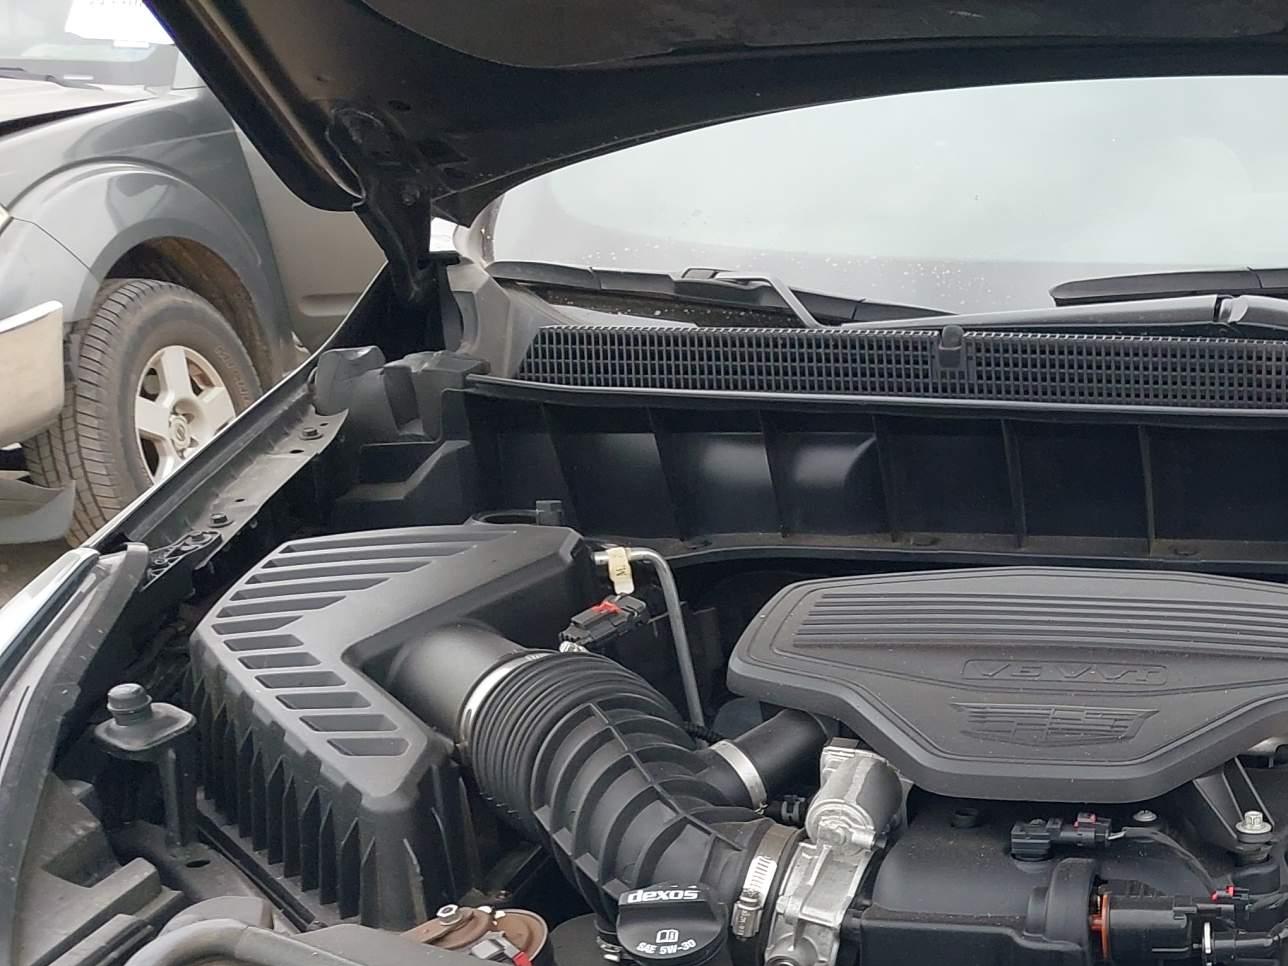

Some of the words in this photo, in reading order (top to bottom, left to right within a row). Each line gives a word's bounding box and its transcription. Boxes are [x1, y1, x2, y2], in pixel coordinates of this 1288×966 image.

[626, 889, 701, 904] dexos
[636, 942, 658, 954] SAE
[659, 939, 697, 955] 5W-30
